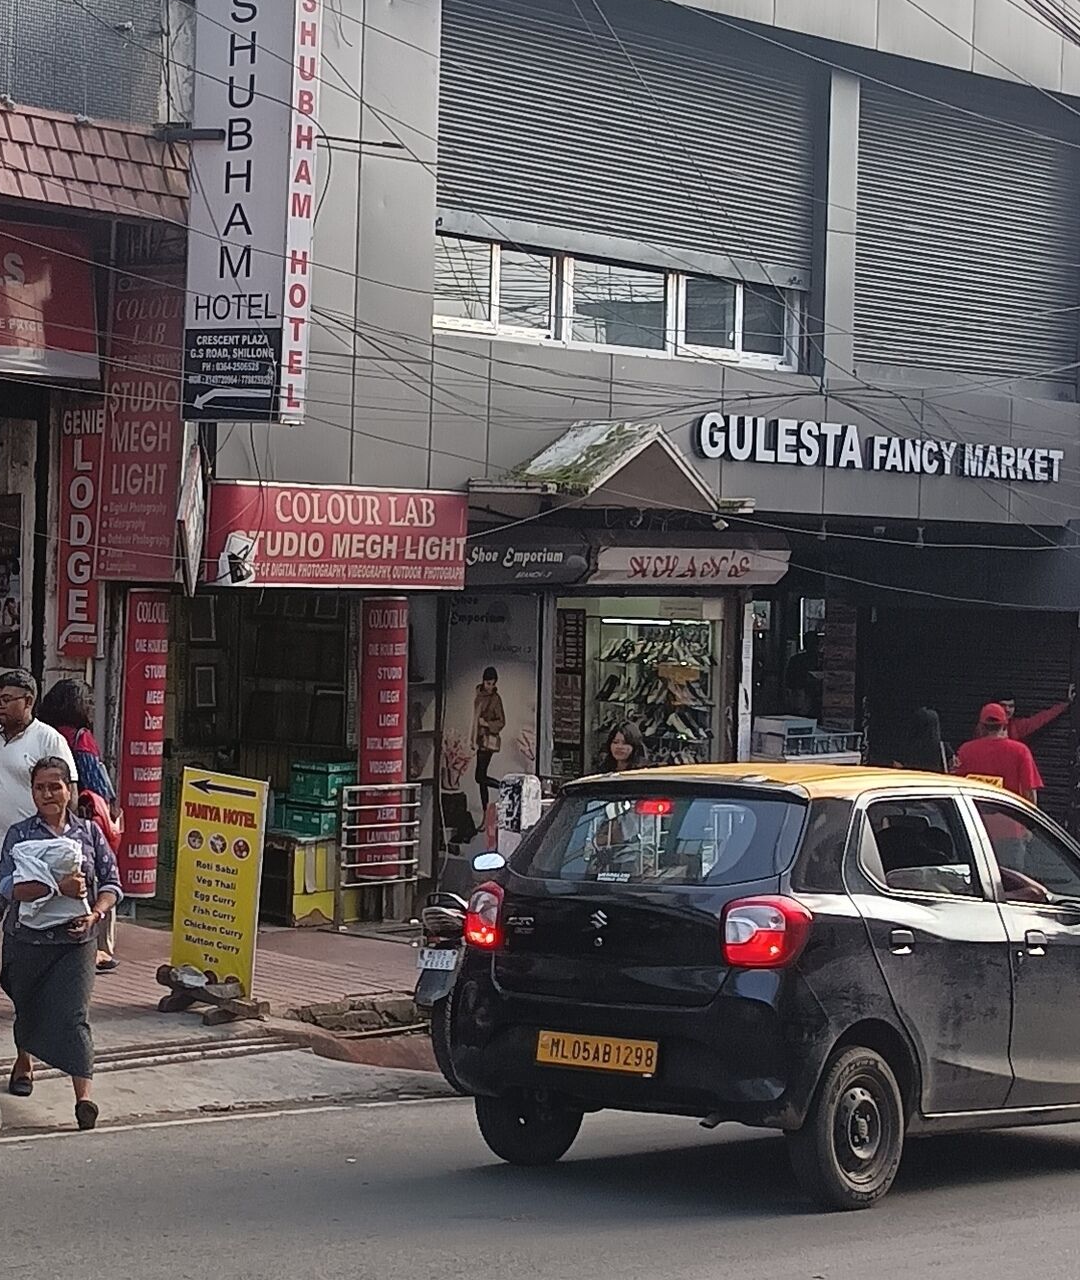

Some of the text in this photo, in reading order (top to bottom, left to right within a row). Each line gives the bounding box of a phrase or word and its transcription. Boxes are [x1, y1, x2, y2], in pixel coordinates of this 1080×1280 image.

[194, 293, 278, 321] HOTEL
[286, 249, 309, 408] HOTEL
[196, 335, 269, 347] CRESCENT PLAZA
[205, 348, 231, 359] ROAD,
[232, 347, 275, 359] SHILLONG
[111, 382, 180, 414] STUDIO
[63, 408, 104, 436] GENIE
[111, 421, 171, 453] MEGH
[699, 412, 1065, 483] GULESTA FANCY MARKET
[111, 463, 169, 495] LIGHT
[275, 490, 437, 528] COLOUR LAB
[67, 438, 95, 622] LODGE
[331, 533, 398, 560] MEGH
[404, 534, 467, 562] LIGHT
[466, 546, 564, 568] Shoe Emporium
[271, 563, 297, 576] DIGITAL
[377, 666, 403, 680] STUDIO
[378, 713, 400, 727] LIGHT
[184, 801, 258, 830] TANIYA HOTEL
[195, 859, 239, 876] Roti Sabzi
[195, 875, 237, 891] Veg Thali
[193, 890, 237, 908] Egg Curry
[192, 905, 237, 923] Fish Curry
[183, 918, 244, 940] Chicken Curry
[184, 933, 241, 955] Mutton Curry
[202, 953, 220, 964] Tea
[549, 1037, 655, 1068] ML05AB1298
